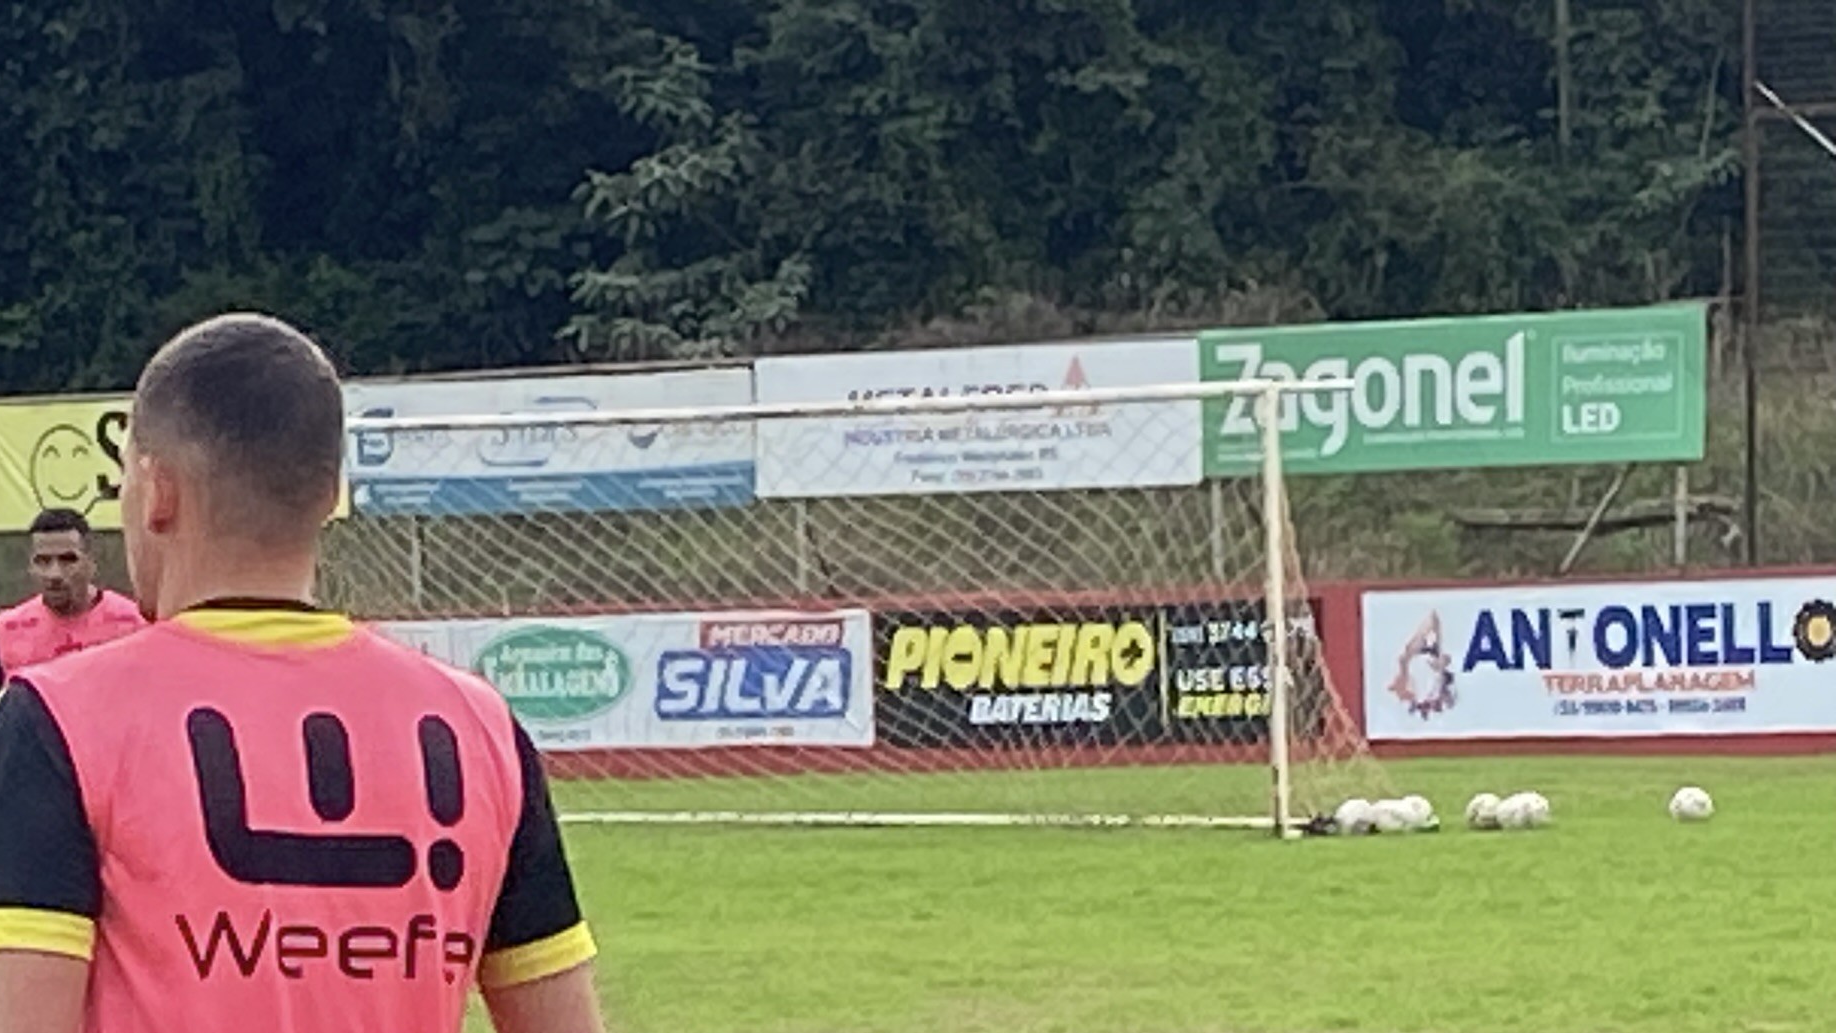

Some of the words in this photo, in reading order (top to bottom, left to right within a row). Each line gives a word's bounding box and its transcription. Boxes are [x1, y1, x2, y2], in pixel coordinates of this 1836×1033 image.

[1216, 330, 1525, 457] Zagonel
[1562, 402, 1622, 434] LED
[708, 623, 841, 647] MERCADO
[884, 621, 1154, 691] PIONEIRO
[659, 658, 844, 713] SILVA
[1177, 667, 1226, 692] USE
[1542, 669, 1756, 694] TERRAPLANAGEM
[969, 692, 1112, 725] BATERIAS
